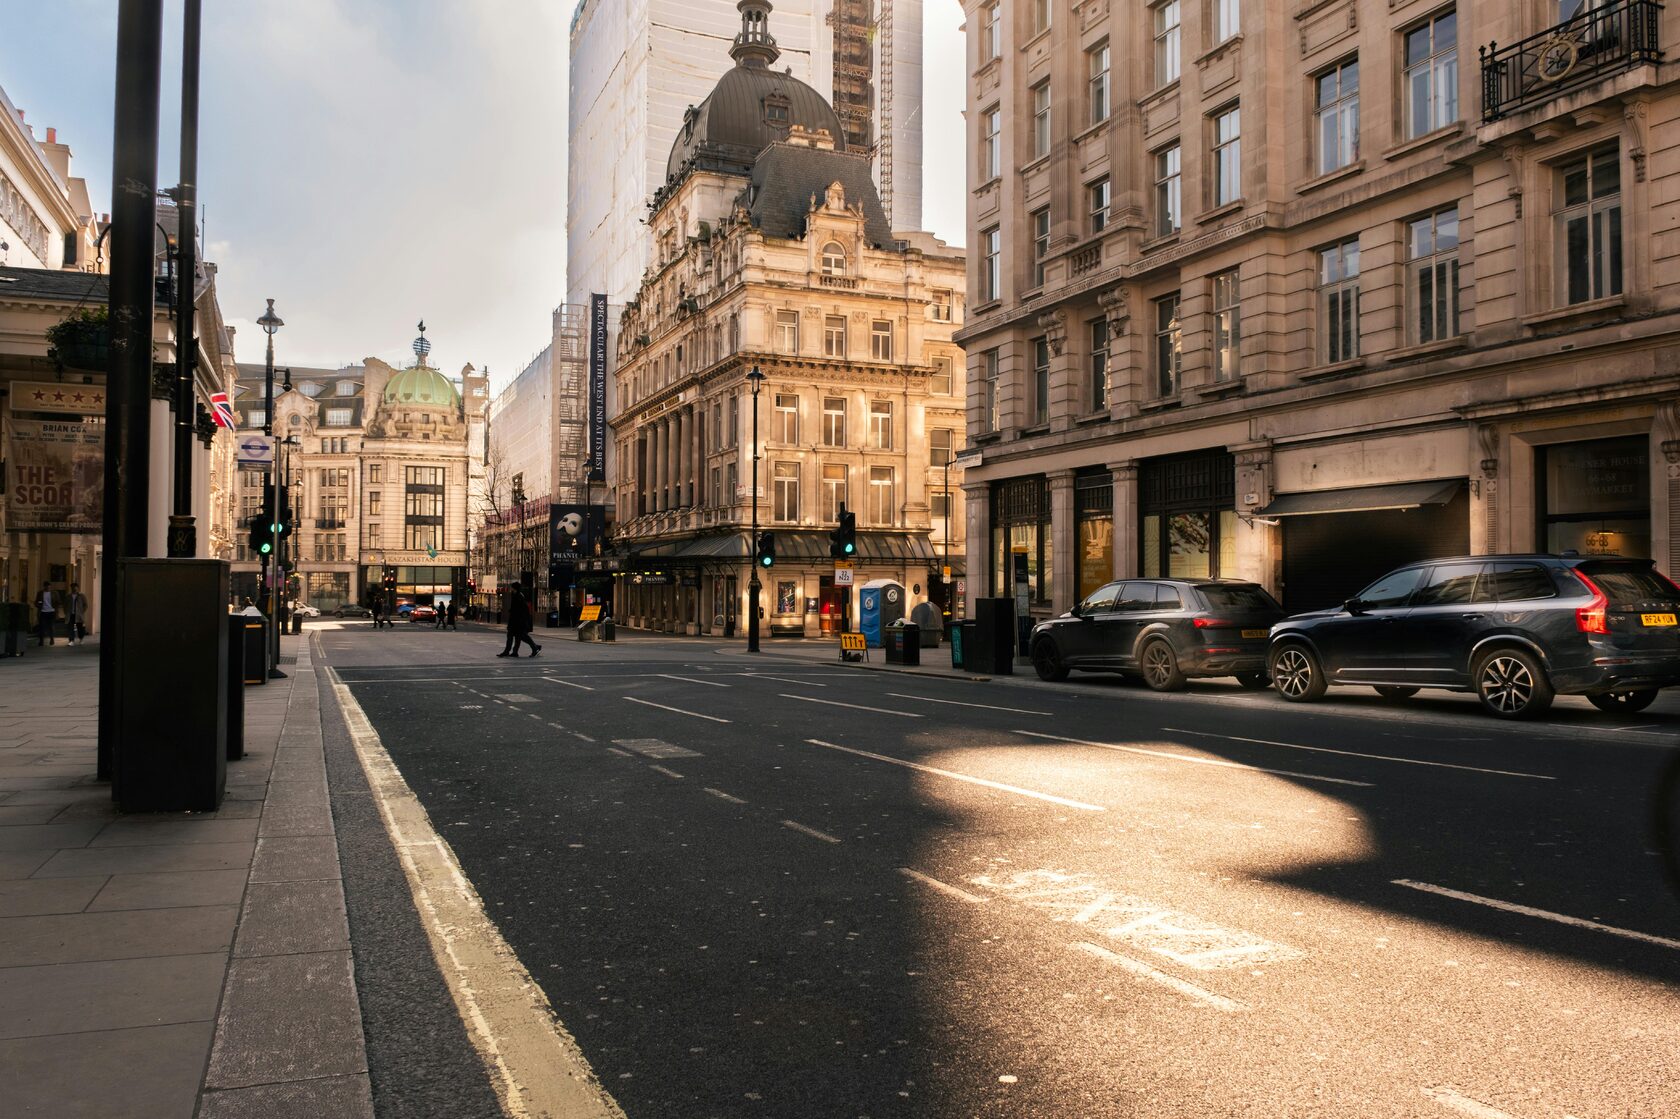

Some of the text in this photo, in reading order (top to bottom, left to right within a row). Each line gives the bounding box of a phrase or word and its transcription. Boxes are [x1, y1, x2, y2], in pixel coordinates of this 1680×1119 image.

[596, 300, 605, 361] SPECTACULAR!
[596, 363, 604, 381] THE
[596, 382, 604, 404] WEST
[70, 425, 87, 433] COX
[596, 425, 603, 436] AT
[595, 437, 603, 450] ITS
[1610, 455, 1645, 466] HOUSE
[16, 465, 55, 485] THE
[1585, 535, 1609, 546] 66-68
